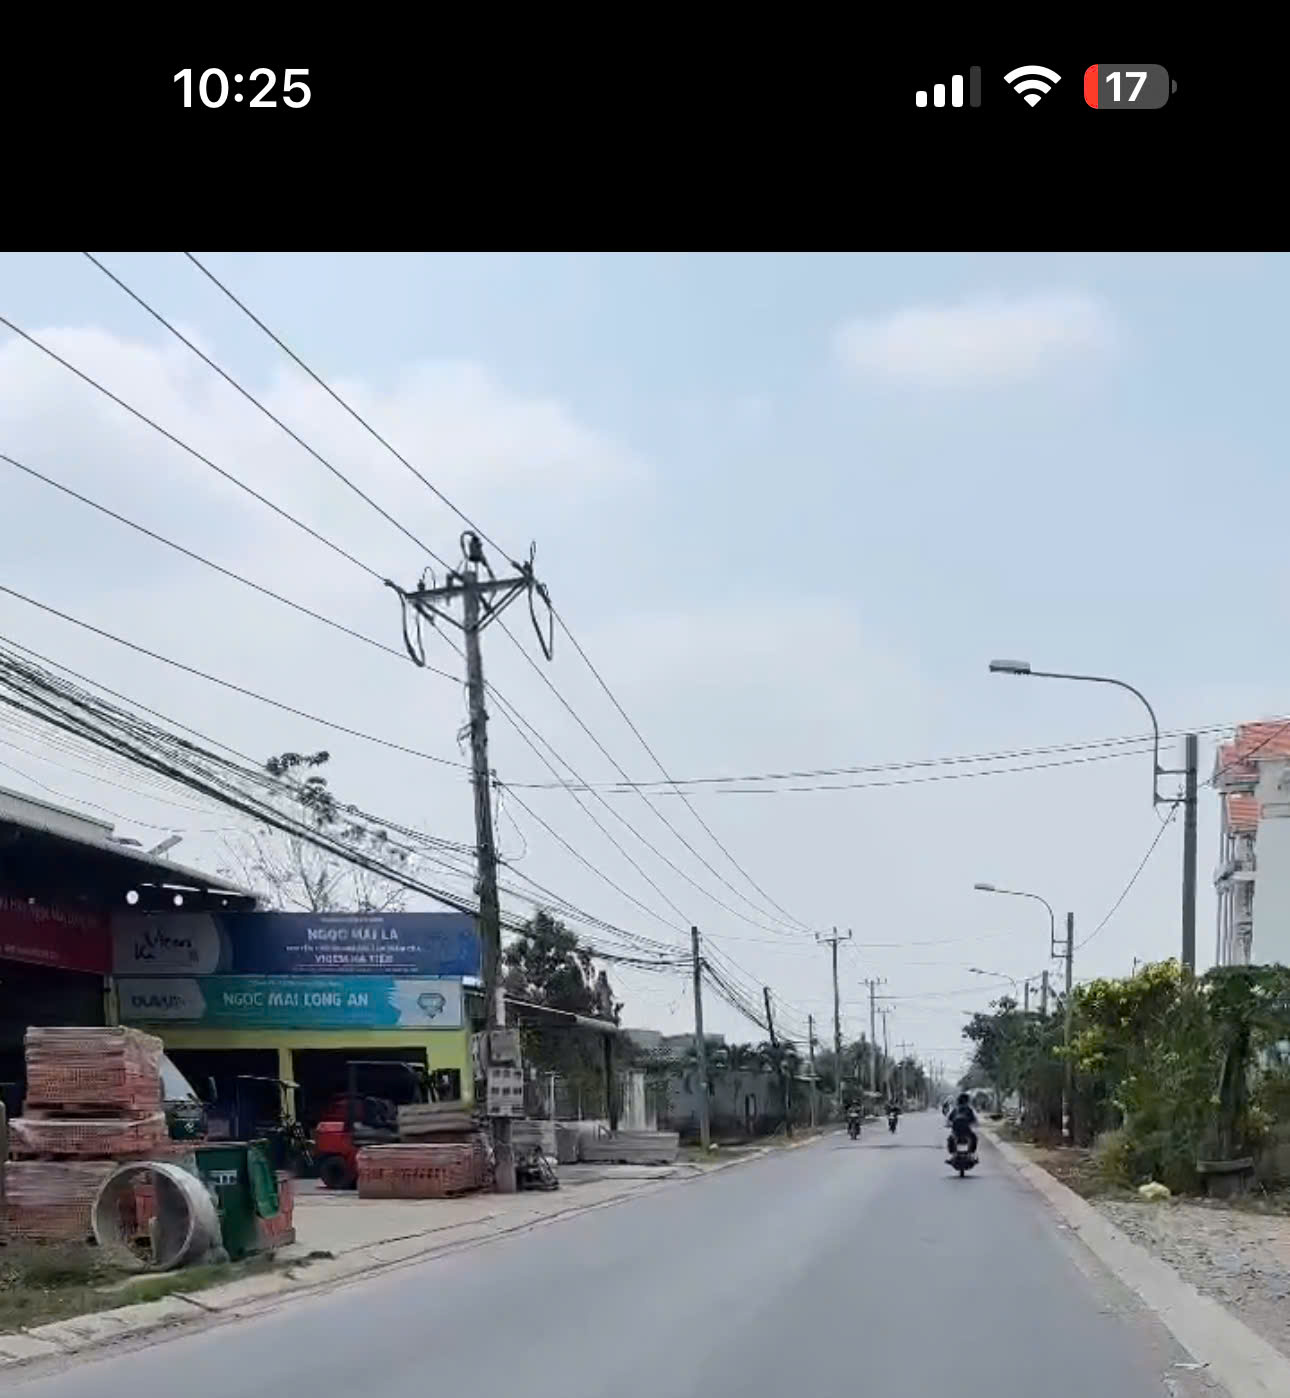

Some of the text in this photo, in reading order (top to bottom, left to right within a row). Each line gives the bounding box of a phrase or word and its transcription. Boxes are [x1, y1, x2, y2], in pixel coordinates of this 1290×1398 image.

[268, 991, 298, 1006] MAI
[304, 991, 341, 1006] LONG
[347, 991, 369, 1006] AN
